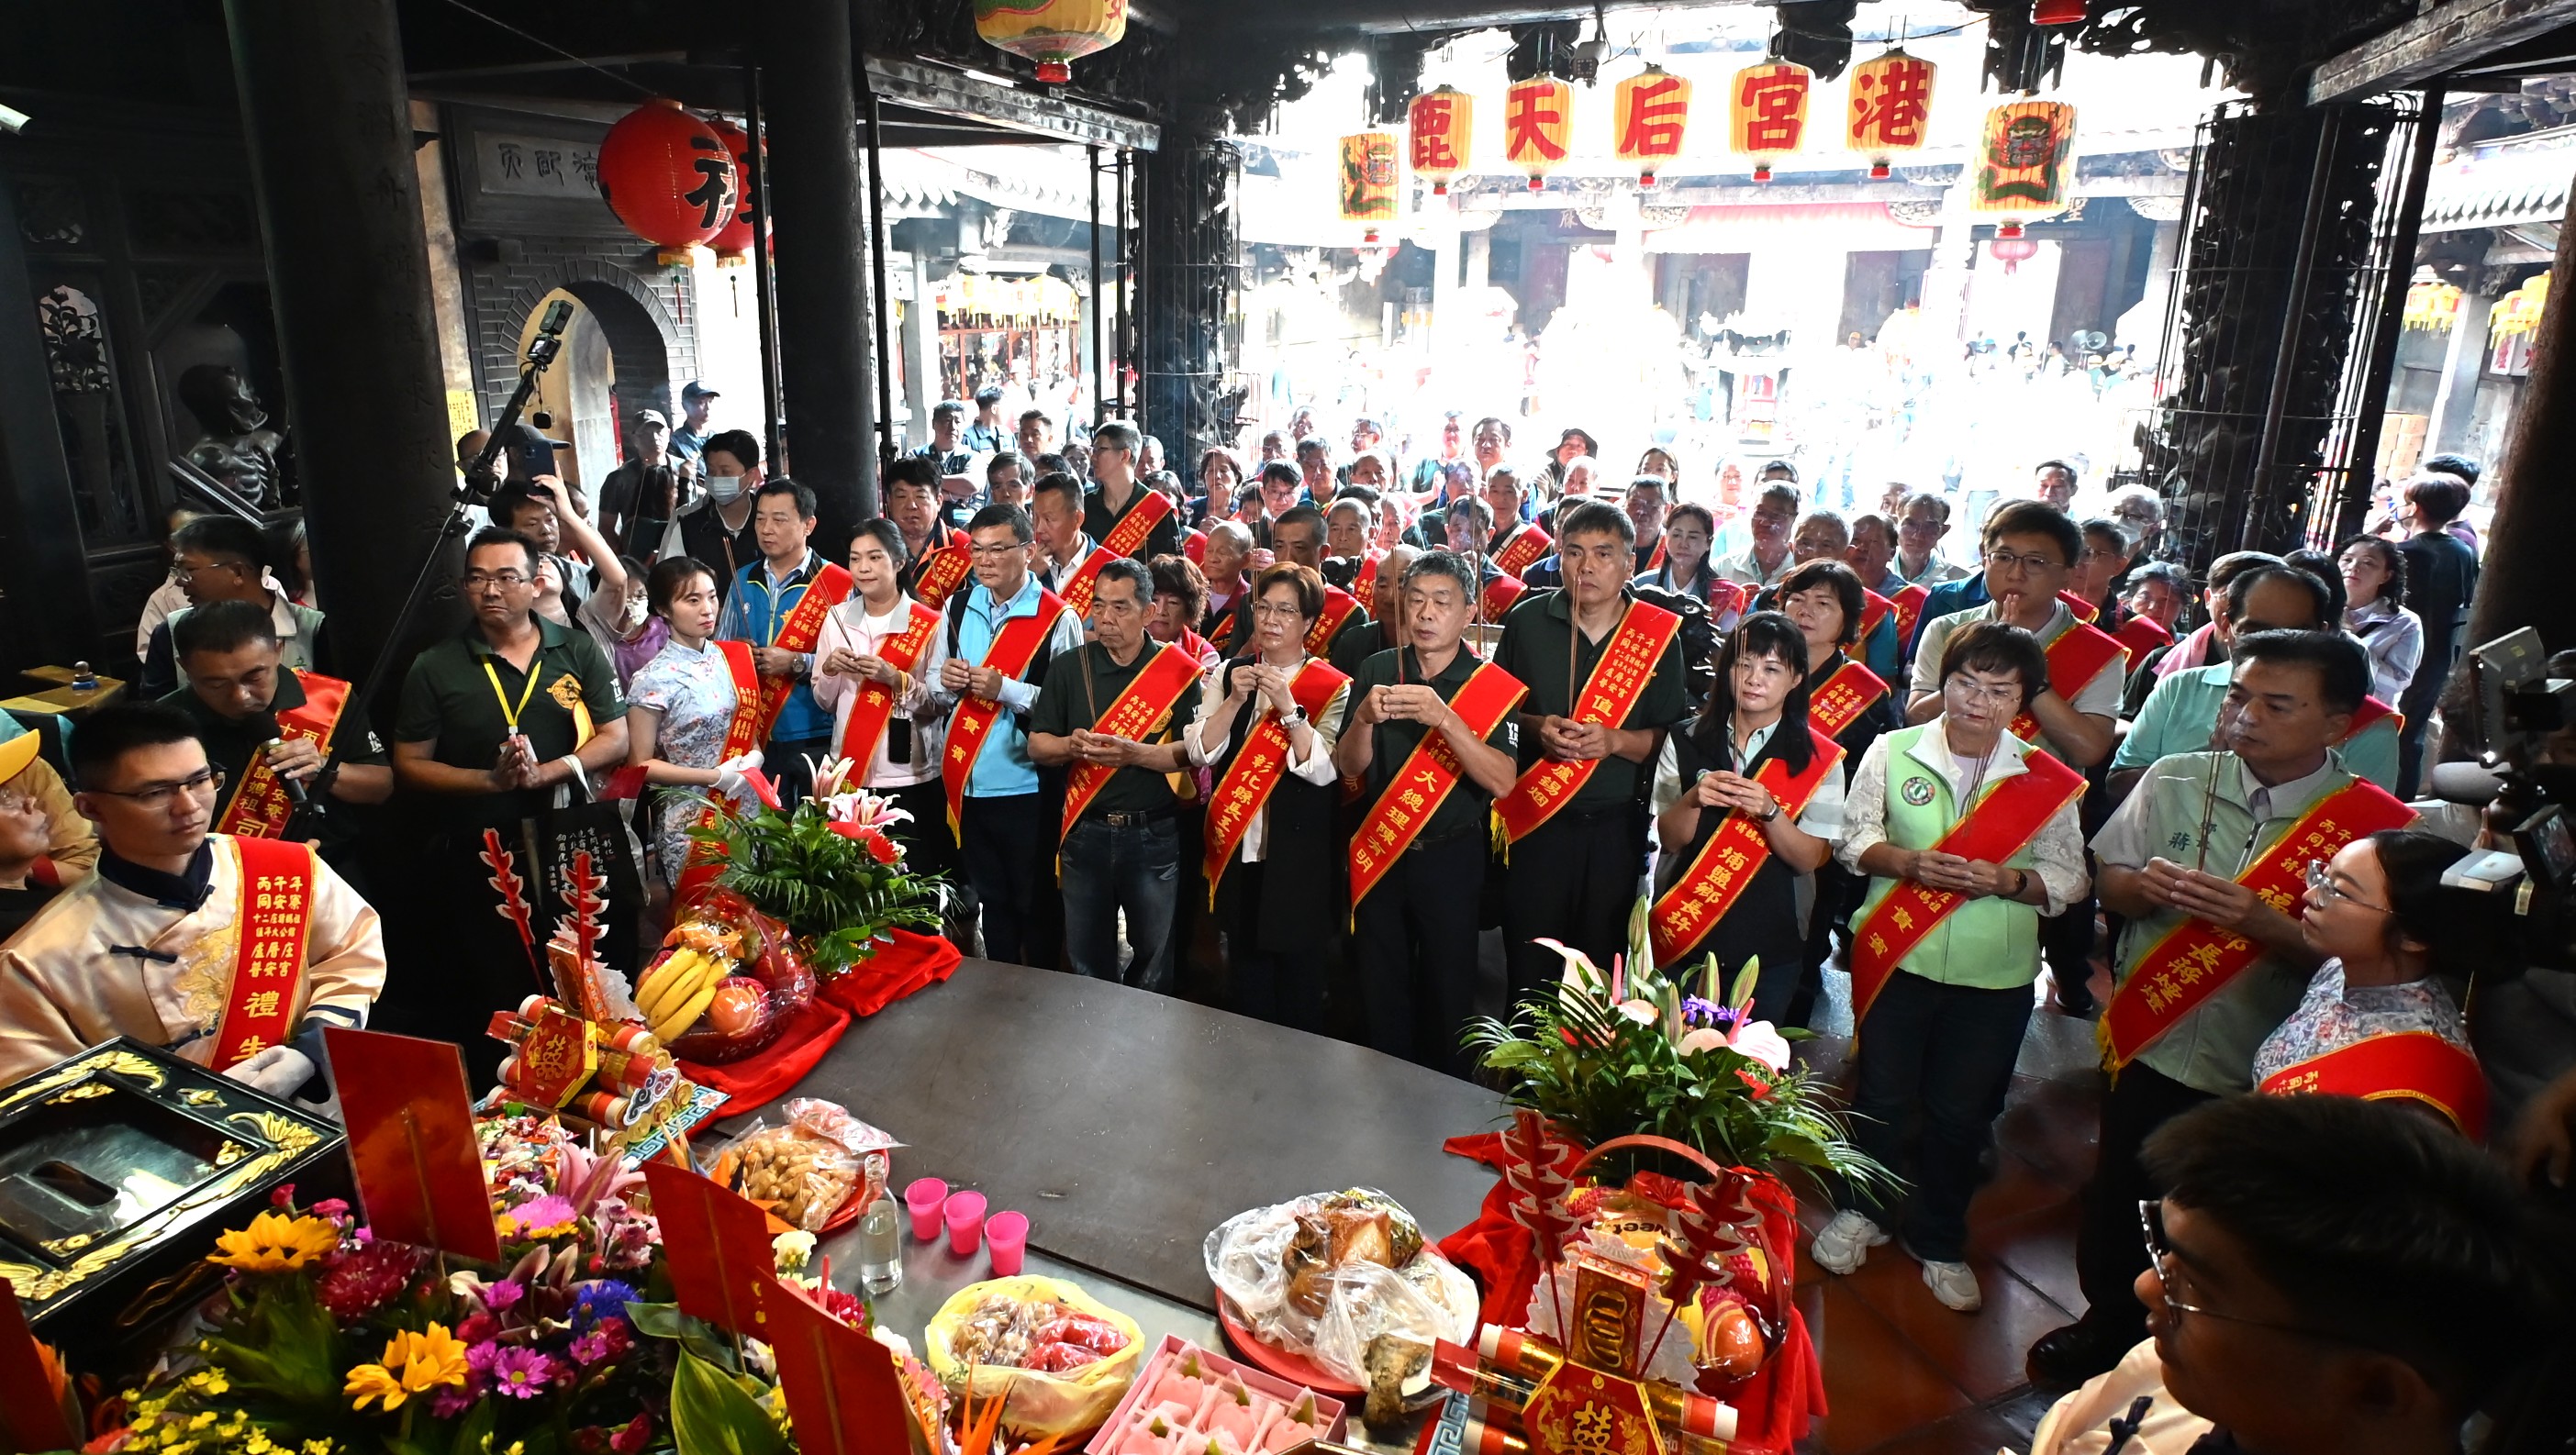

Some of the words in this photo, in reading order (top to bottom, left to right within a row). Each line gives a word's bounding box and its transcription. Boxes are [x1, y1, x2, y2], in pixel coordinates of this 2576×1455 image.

[1620, 638, 1650, 659] 同安寮
[1625, 628, 1656, 648] 丙午年
[1122, 704, 1147, 725] 同安寮
[1130, 695, 1154, 716] 丙午年
[1118, 713, 1140, 735] 十二庄
[1355, 769, 1439, 873] 大總理陳有明
[256, 875, 304, 893] 丙午年
[256, 893, 303, 910] 同安寮
[248, 961, 292, 978] 普安宮
[230, 990, 279, 1061] 禮生
